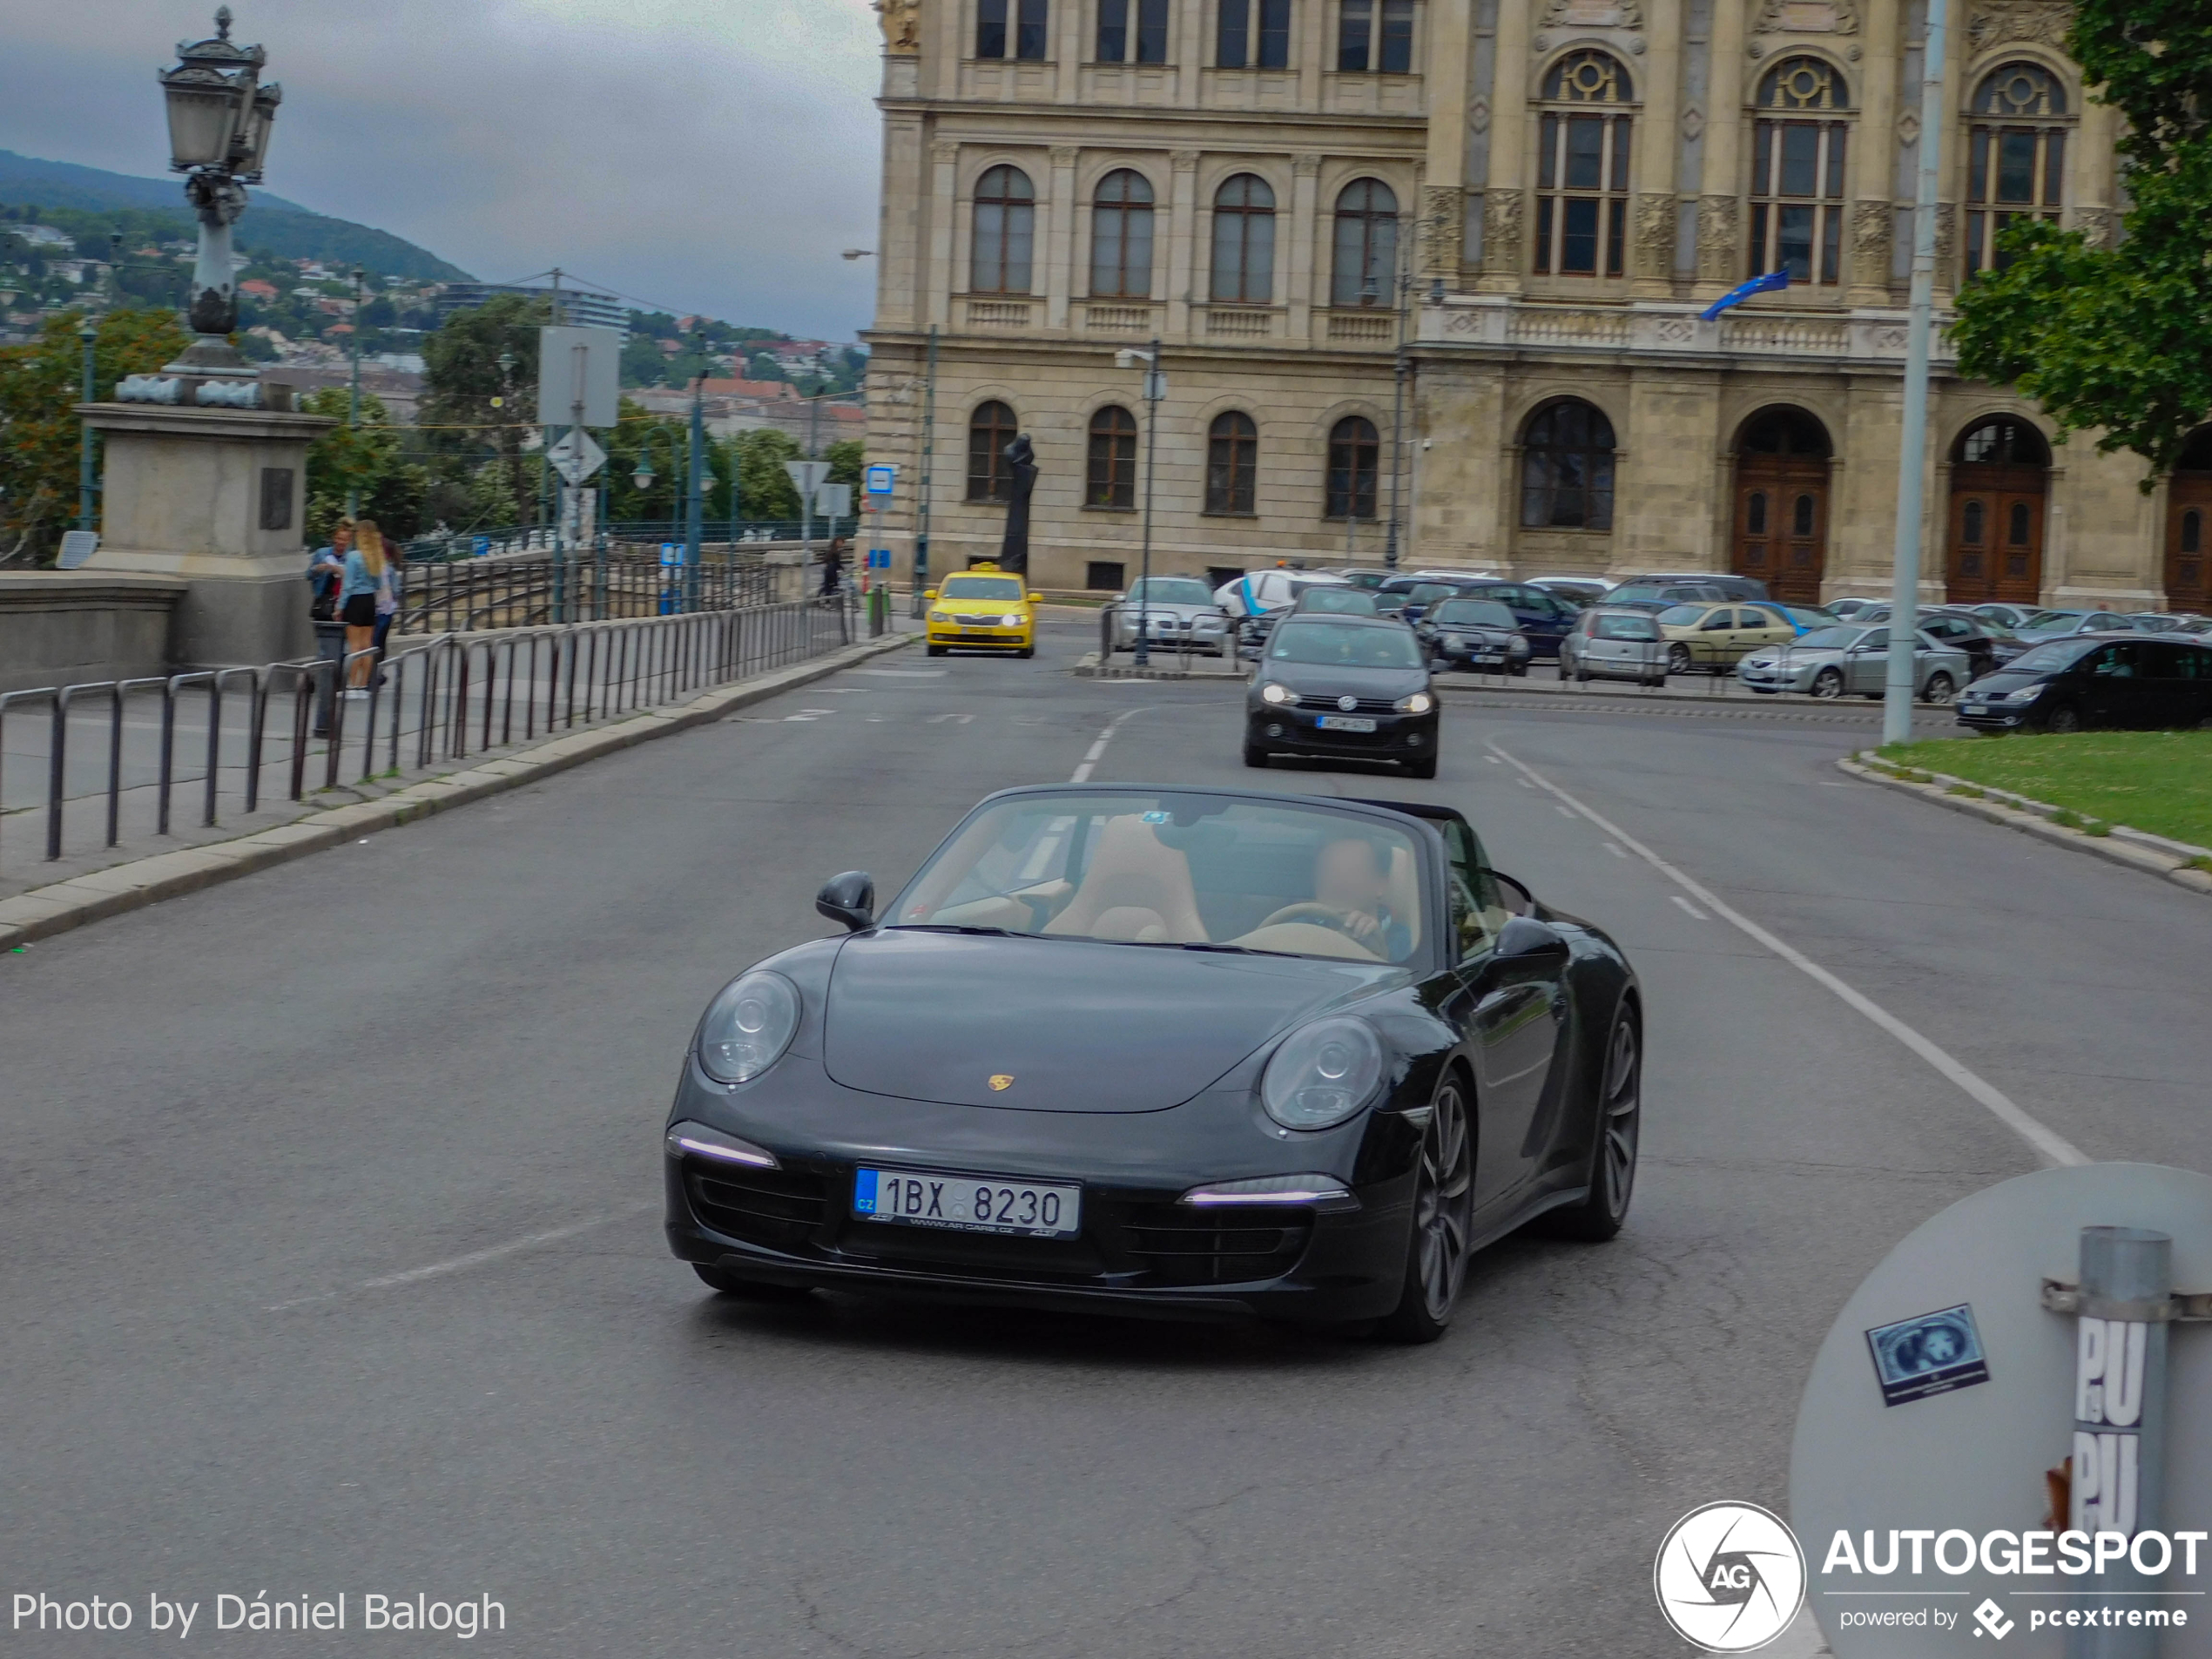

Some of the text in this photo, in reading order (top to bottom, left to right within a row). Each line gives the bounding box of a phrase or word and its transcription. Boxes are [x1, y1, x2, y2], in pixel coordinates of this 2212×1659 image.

[857, 1198, 874, 1211] CZ
[887, 1177, 1060, 1226] 1BX 8230
